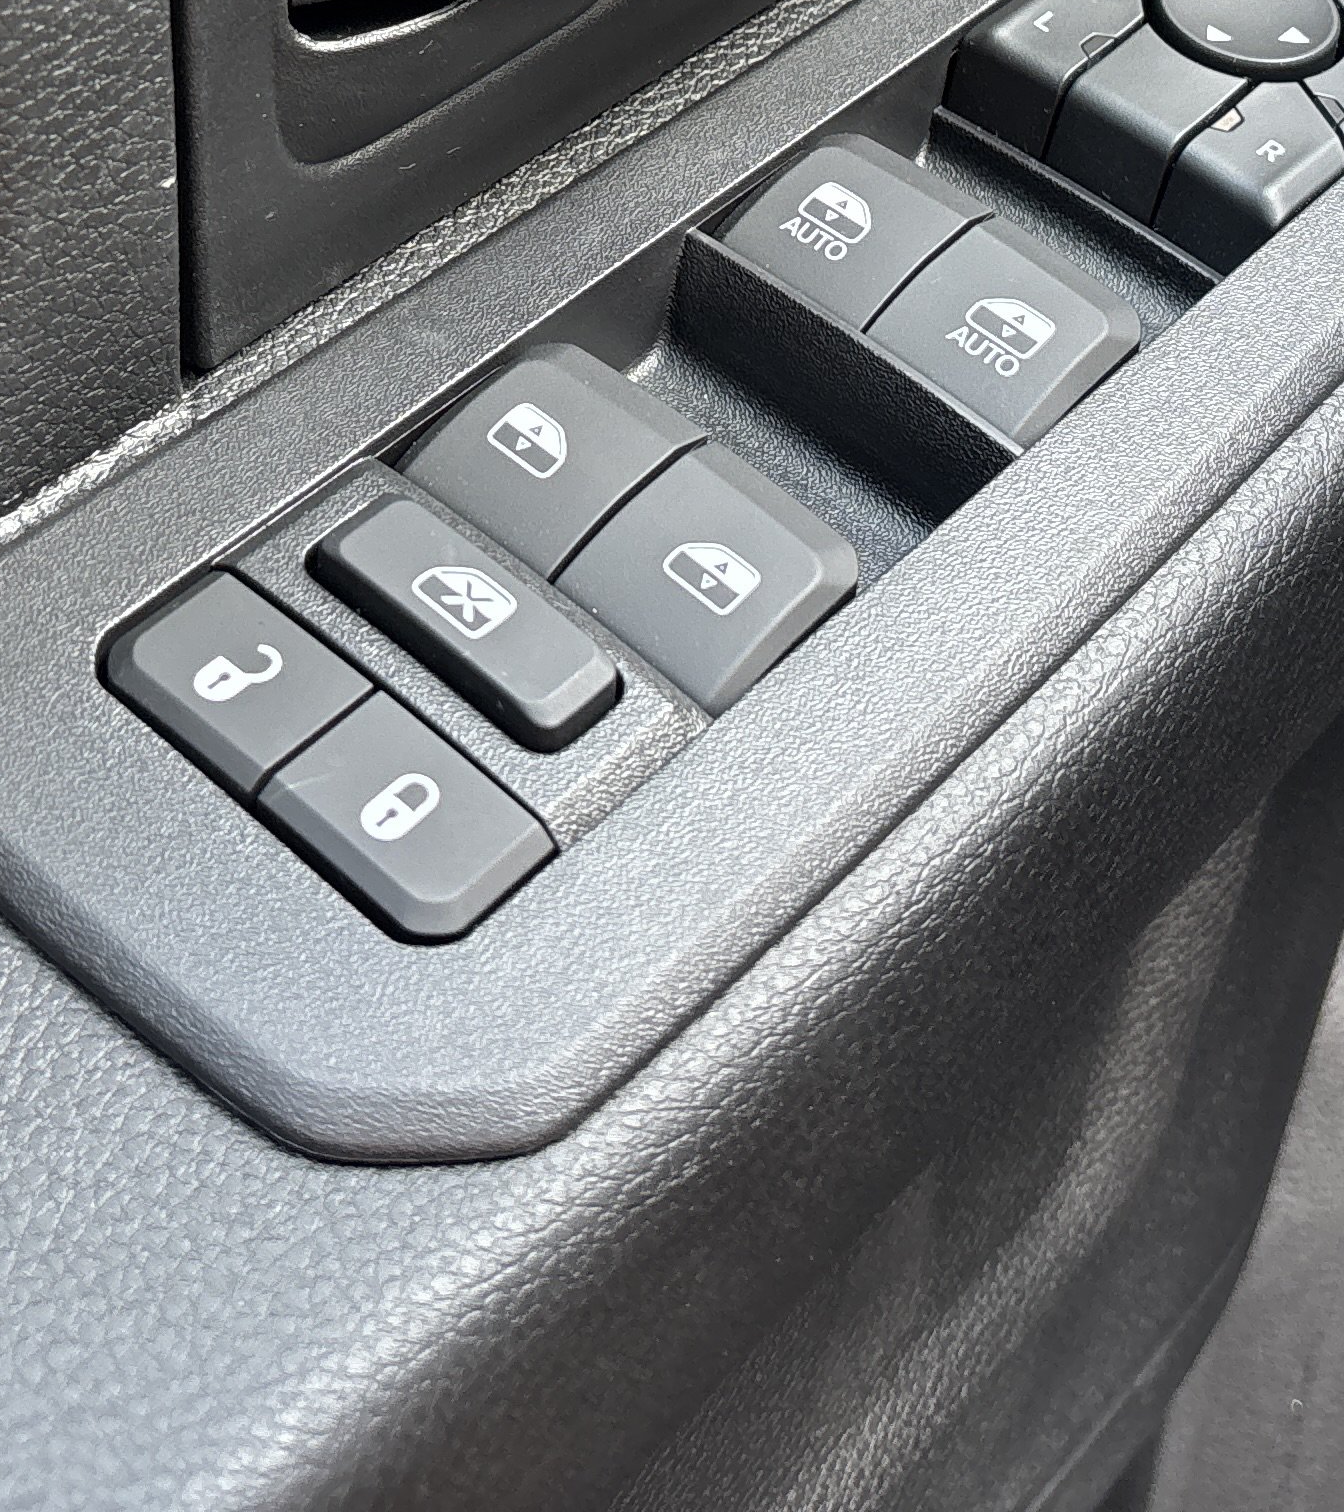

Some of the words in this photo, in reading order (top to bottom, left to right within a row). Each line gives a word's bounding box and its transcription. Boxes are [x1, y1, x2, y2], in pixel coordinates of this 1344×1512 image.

[1032, 9, 1055, 34] L
[1254, 138, 1287, 164] R
[777, 216, 849, 262] AUTO
[944, 325, 1021, 378] AUTO
